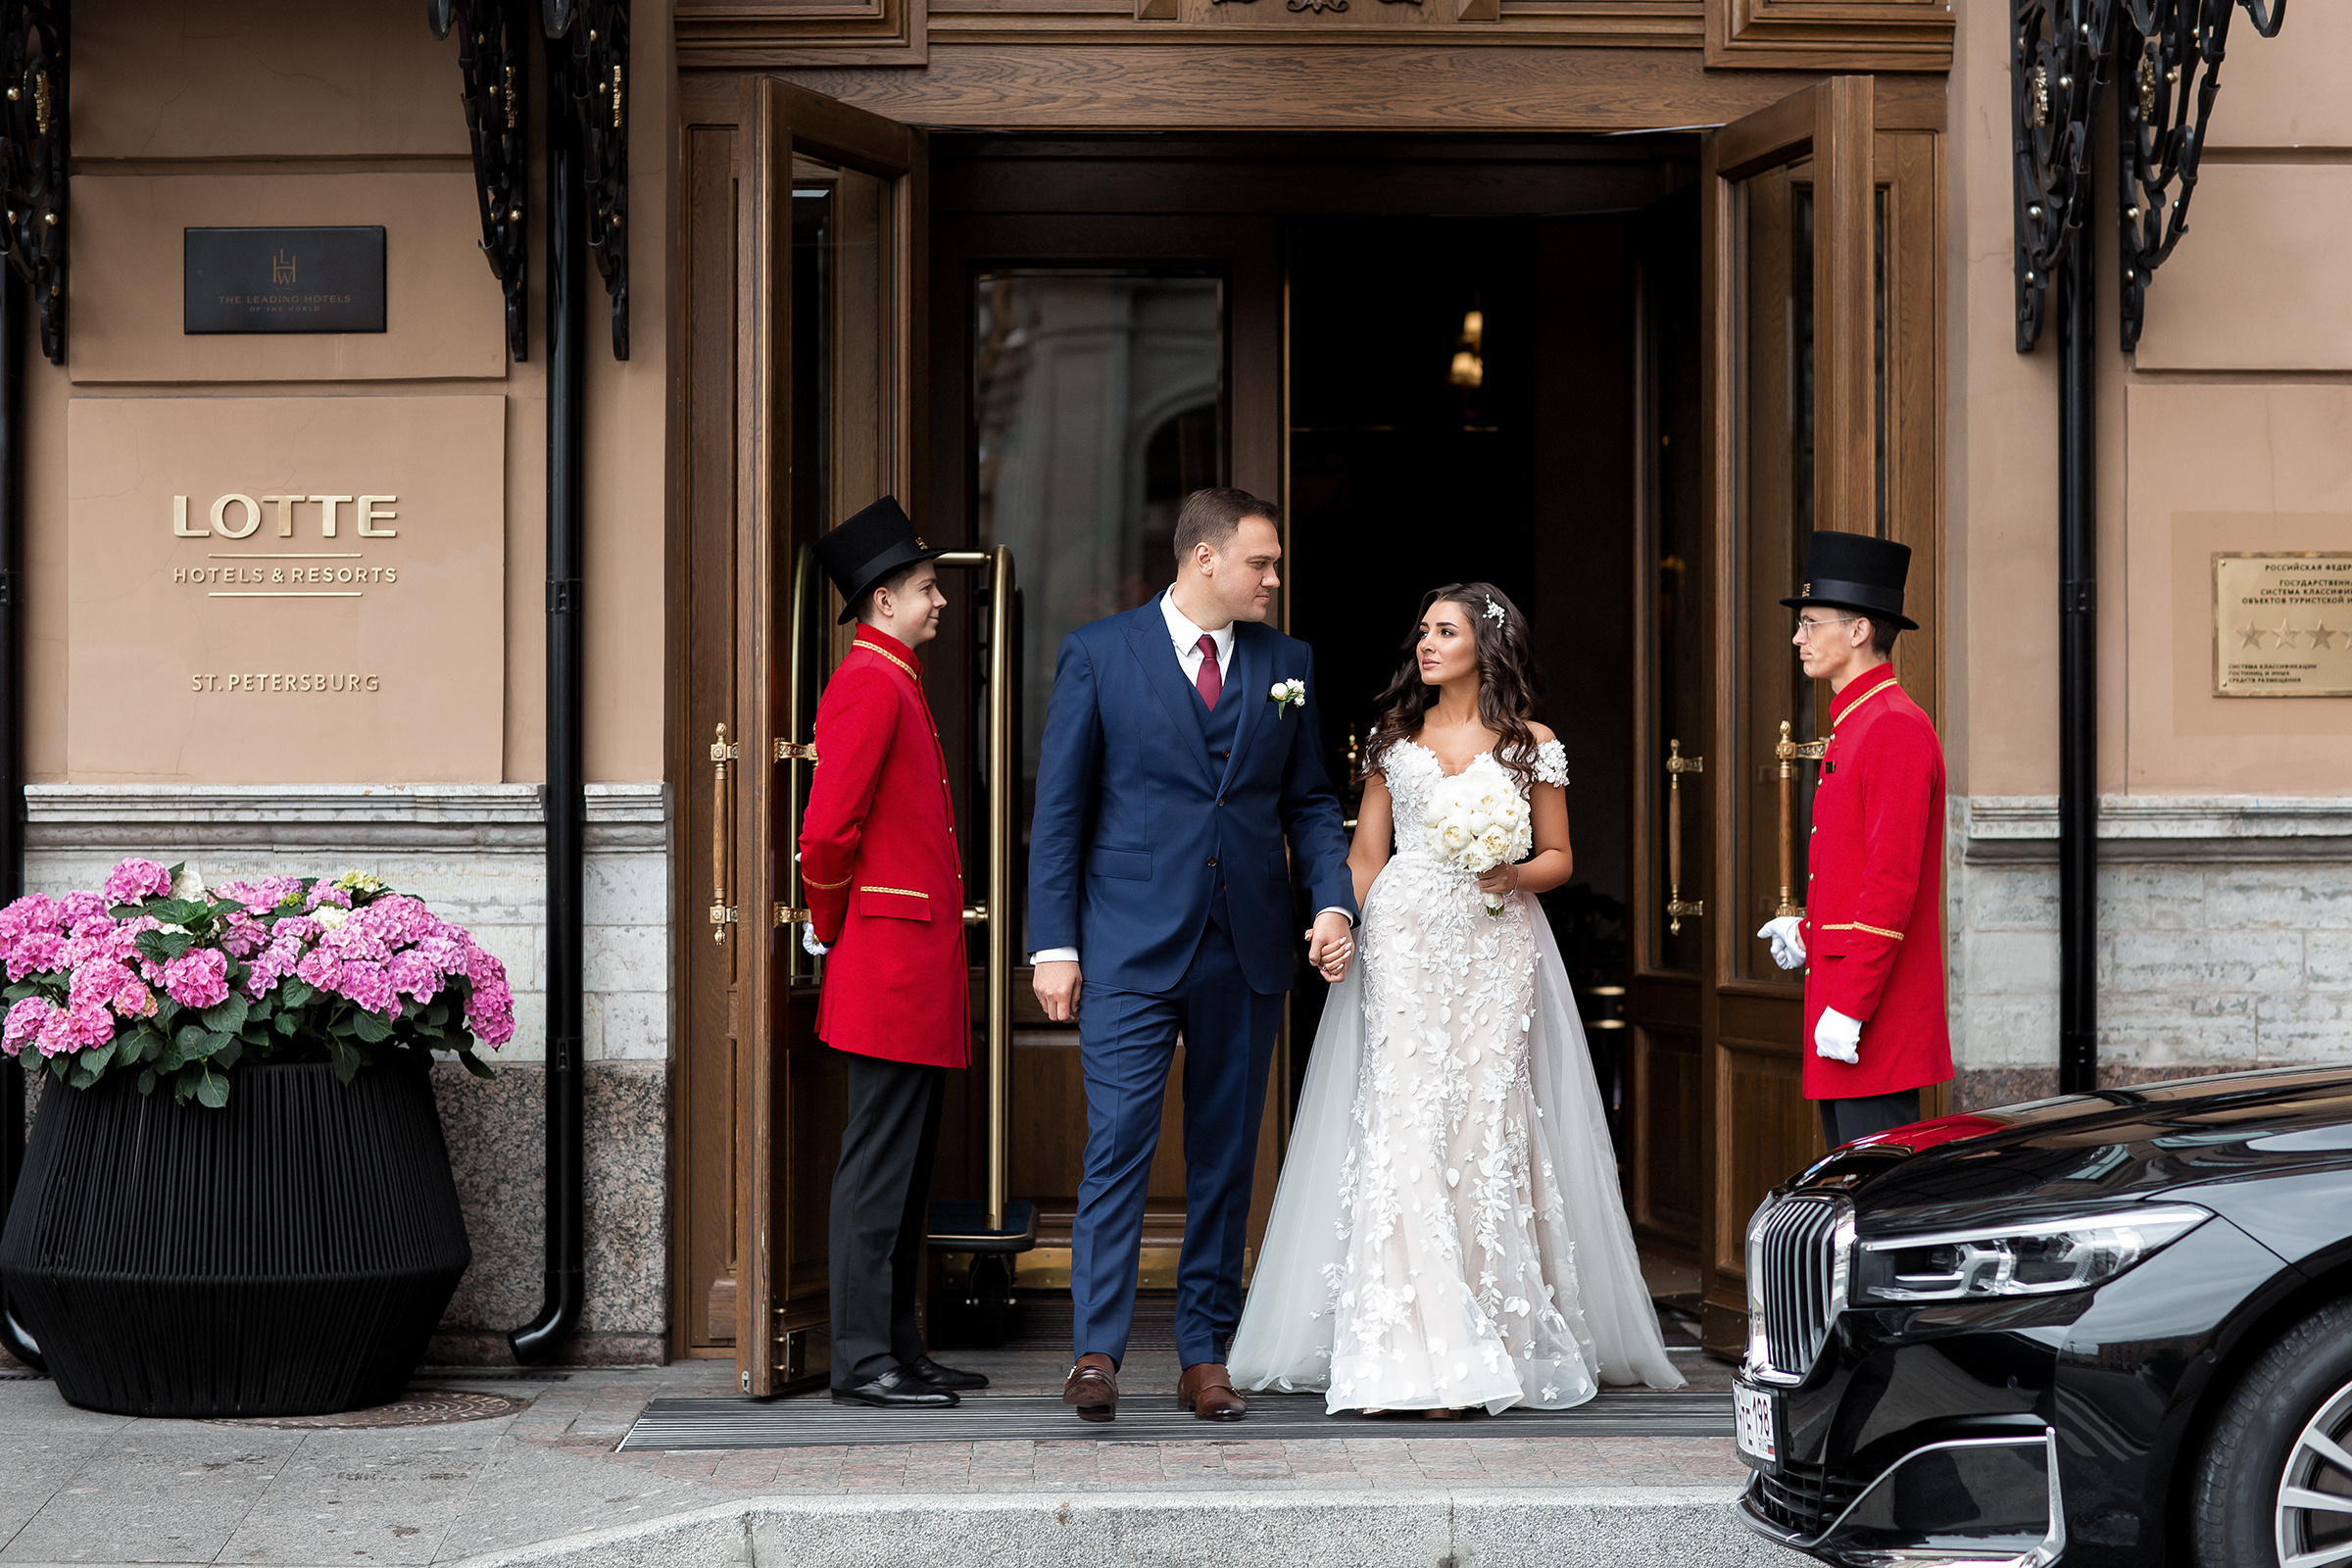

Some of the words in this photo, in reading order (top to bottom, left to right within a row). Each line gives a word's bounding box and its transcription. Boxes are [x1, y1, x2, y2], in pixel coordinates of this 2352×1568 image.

[246, 295, 299, 304] LEADING
[173, 493, 398, 539] LOTTE
[2265, 563, 2323, 571] РОССИЙСКАЯ
[173, 567, 264, 583] HOTELS
[270, 567, 285, 583] &
[292, 566, 398, 583] RESORTS
[2289, 595, 2344, 605] ТУРИСТСКОЙ
[1753, 1396, 1770, 1438] 198
